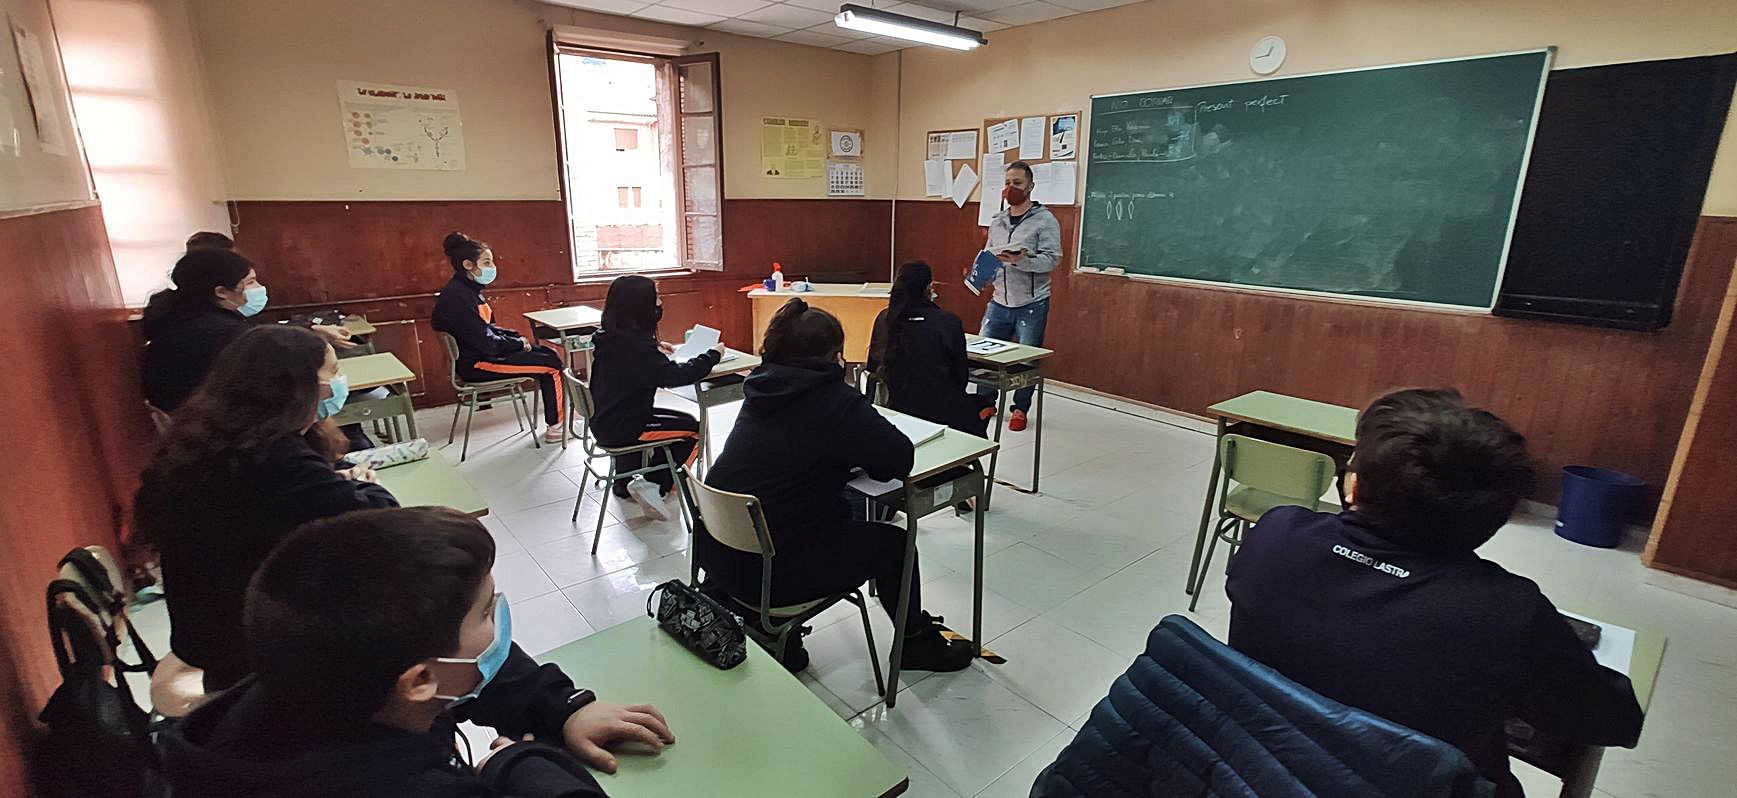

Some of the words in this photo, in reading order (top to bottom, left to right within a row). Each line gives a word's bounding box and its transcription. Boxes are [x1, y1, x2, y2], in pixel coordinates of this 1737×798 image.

[1197, 99, 1234, 112] Present
[1332, 544, 1373, 566] COLEGIO
[1373, 560, 1410, 578] LASTRA
